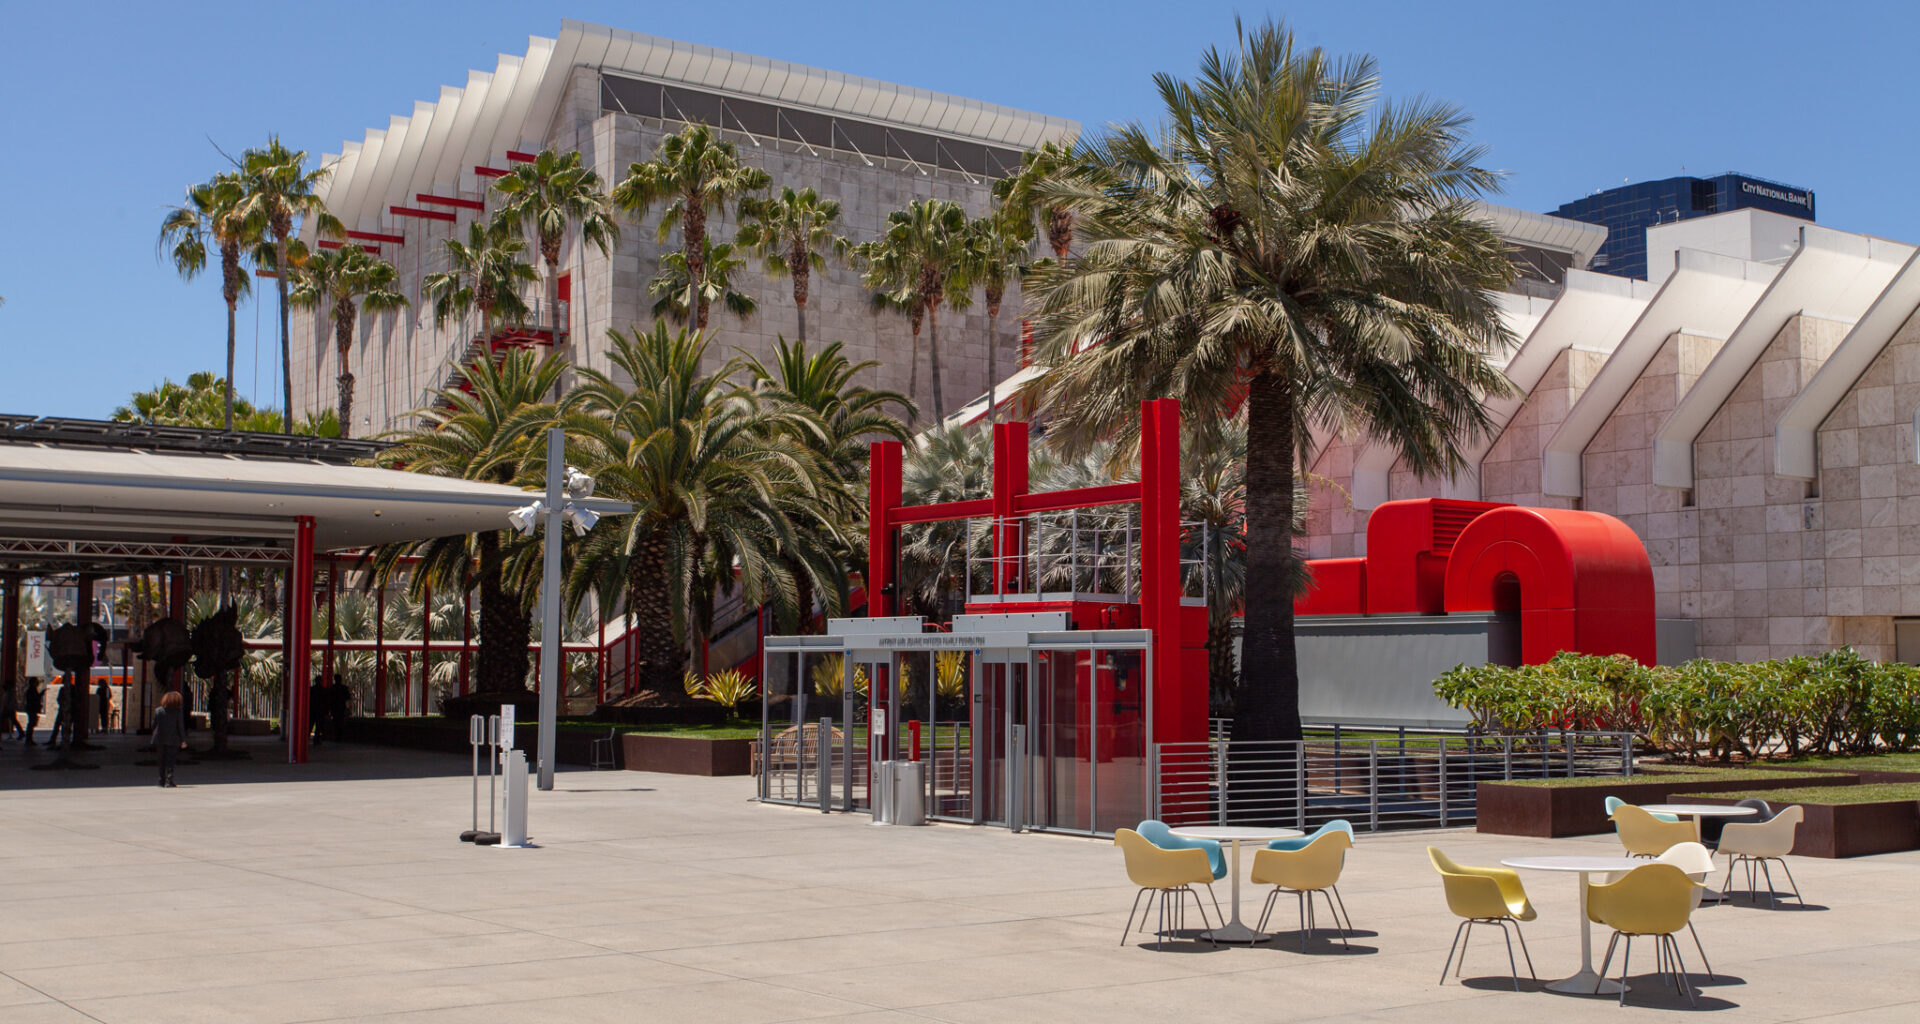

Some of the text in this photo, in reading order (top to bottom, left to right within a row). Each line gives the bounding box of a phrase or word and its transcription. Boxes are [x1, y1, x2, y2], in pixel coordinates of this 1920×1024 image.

[1756, 184, 1789, 201] NATIONAL
[1788, 192, 1807, 206] BANK
[32, 635, 41, 658] LACMA
